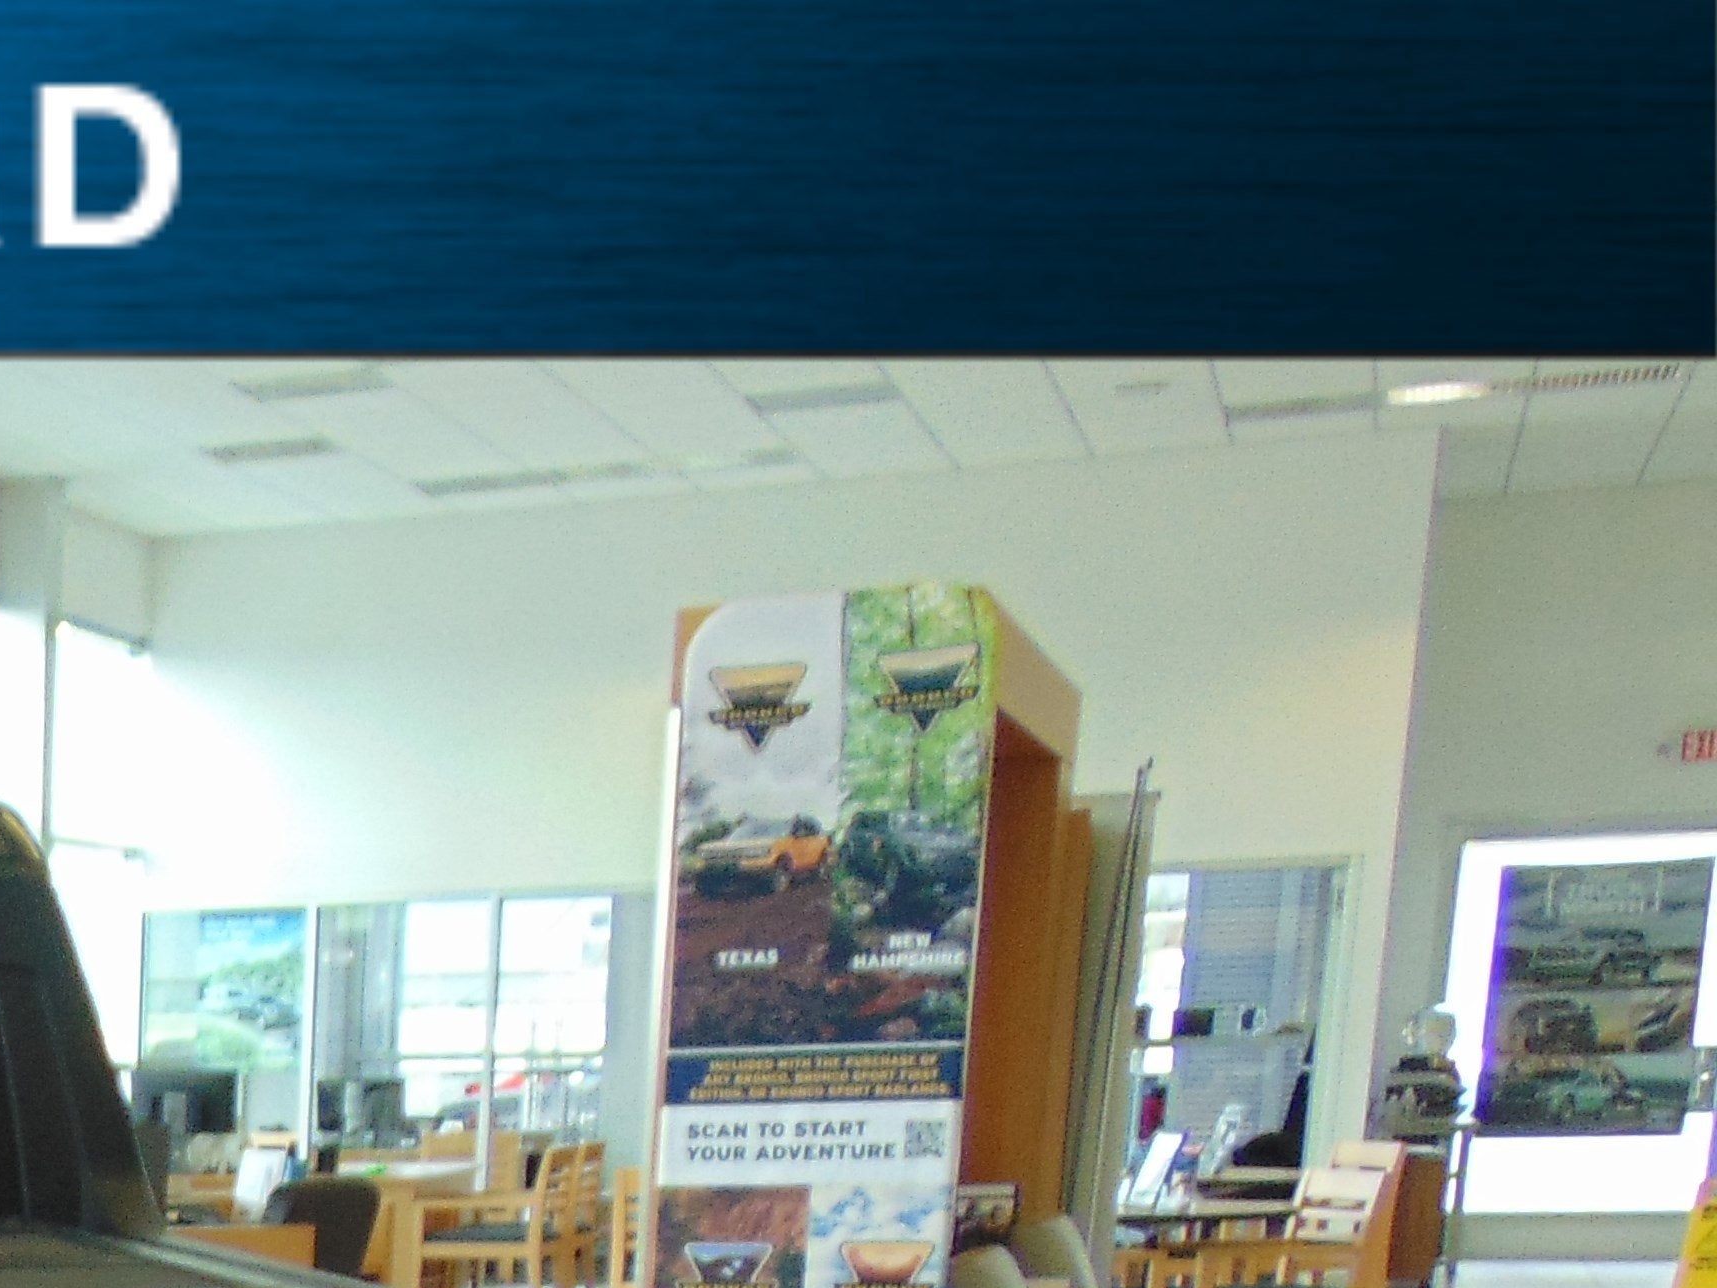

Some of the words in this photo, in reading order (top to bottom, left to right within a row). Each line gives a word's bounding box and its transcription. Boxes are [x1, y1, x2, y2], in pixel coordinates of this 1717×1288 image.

[889, 932, 932, 949] NEW
[717, 948, 779, 967] TEXAS
[852, 950, 965, 969] HAMPSHIRE
[687, 1122, 748, 1139] SCAN
[758, 1121, 785, 1138] TO
[794, 1120, 867, 1137] START
[687, 1145, 747, 1161] YOUR
[755, 1143, 897, 1161] ADVENTURE
